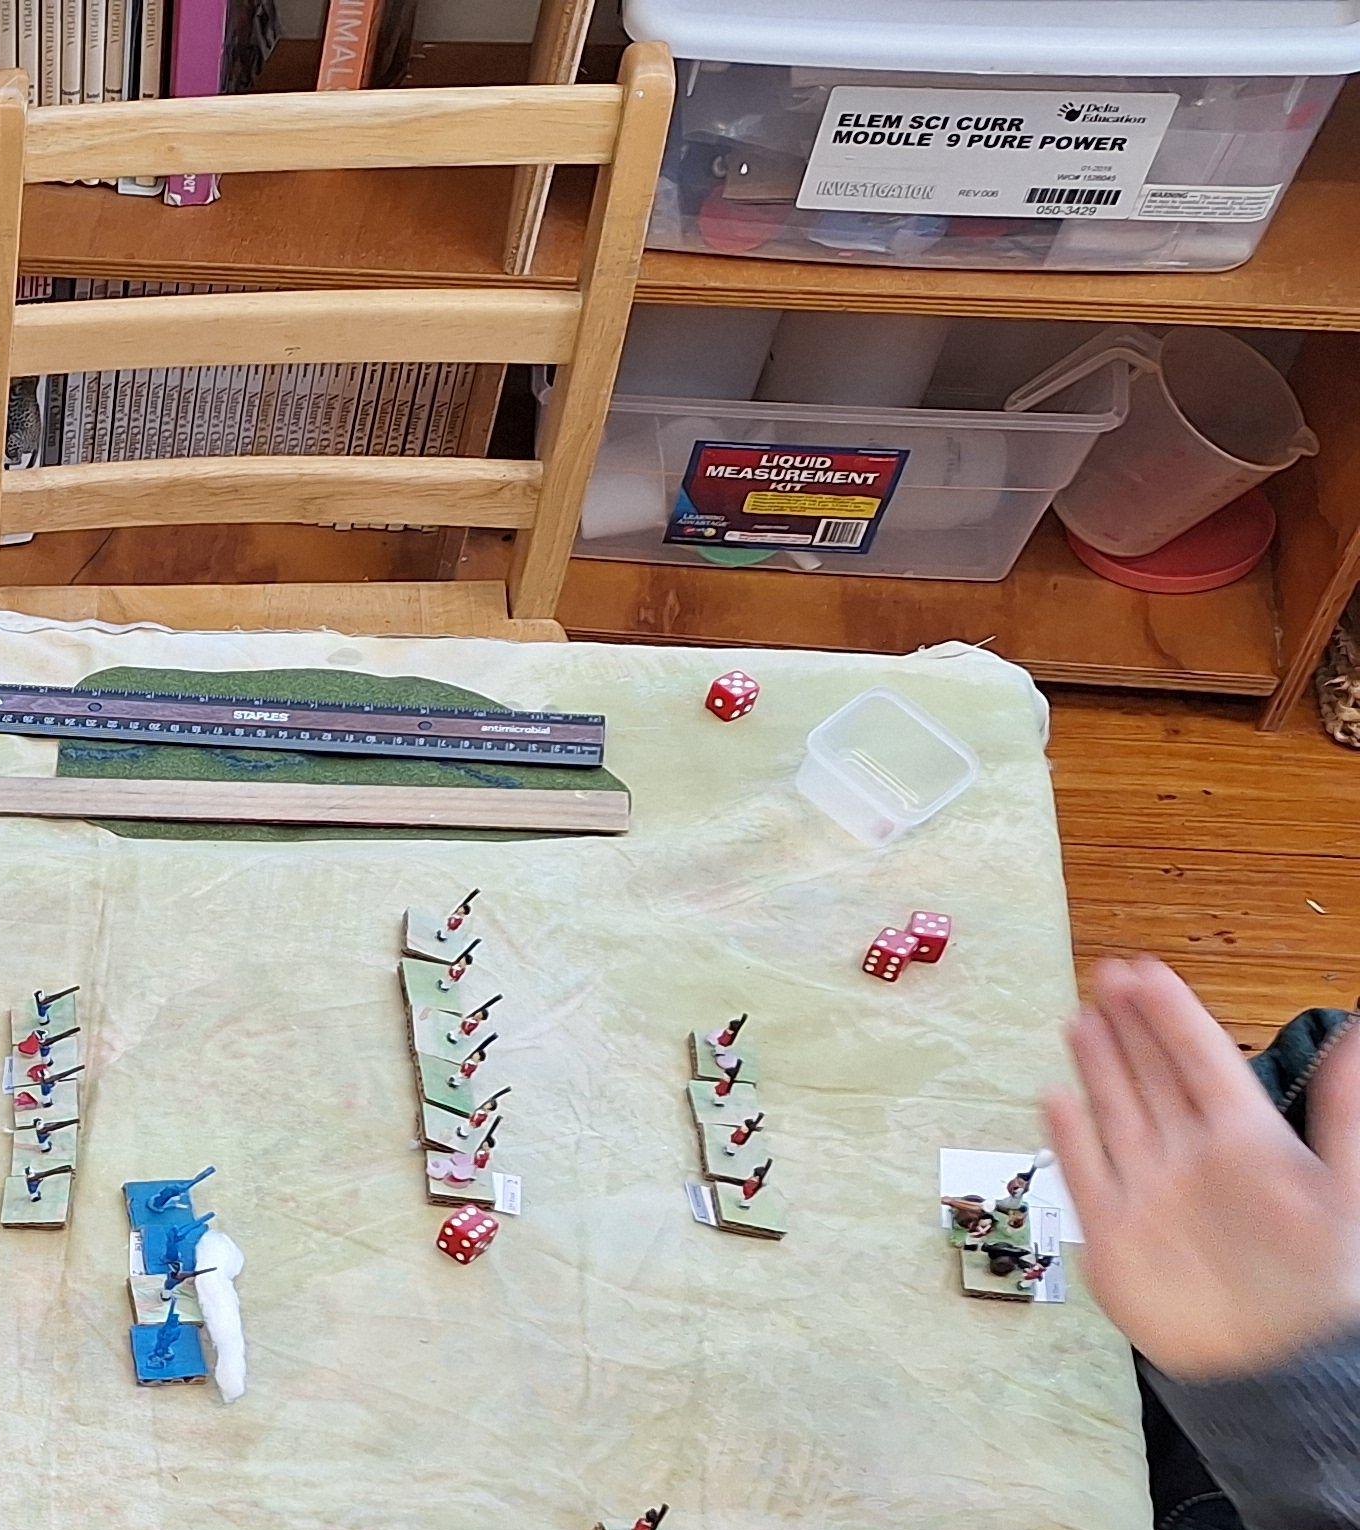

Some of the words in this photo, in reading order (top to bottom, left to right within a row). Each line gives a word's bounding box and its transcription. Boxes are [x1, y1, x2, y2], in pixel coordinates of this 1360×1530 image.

[837, 113, 903, 129] ELEM
[909, 115, 947, 130] SCI
[956, 117, 1024, 132] CURR
[1081, 113, 1146, 125] Education
[1085, 103, 1120, 114] Delta
[832, 130, 932, 147] MODULE
[946, 134, 961, 148] 9
[967, 134, 1033, 150] PURE
[1039, 136, 1128, 152] POWER
[816, 181, 937, 200] INVESTIGATION
[1035, 205, 1097, 216] 050-3429
[18, 276, 52, 298] LIFE
[66, 385, 80, 426] Nature's
[84, 376, 98, 418] Nature's
[98, 383, 112, 424] Nature's
[116, 381, 130, 422] Nature's
[132, 381, 146, 422] Nature's
[148, 383, 162, 423] Nature's
[163, 385, 178, 425] Nature's
[179, 388, 194, 425] Nature's
[196, 387, 211, 428] Nature's
[212, 388, 227, 428] Nature's
[228, 388, 242, 428] Nature's
[243, 392, 259, 432] Nature's
[706, 466, 880, 485] MEASUREMENT
[759, 454, 831, 469] LIQUID
[769, 483, 806, 492] KIT
[233, 711, 290, 722] STAPLES
[480, 725, 550, 736] antimicrobial
